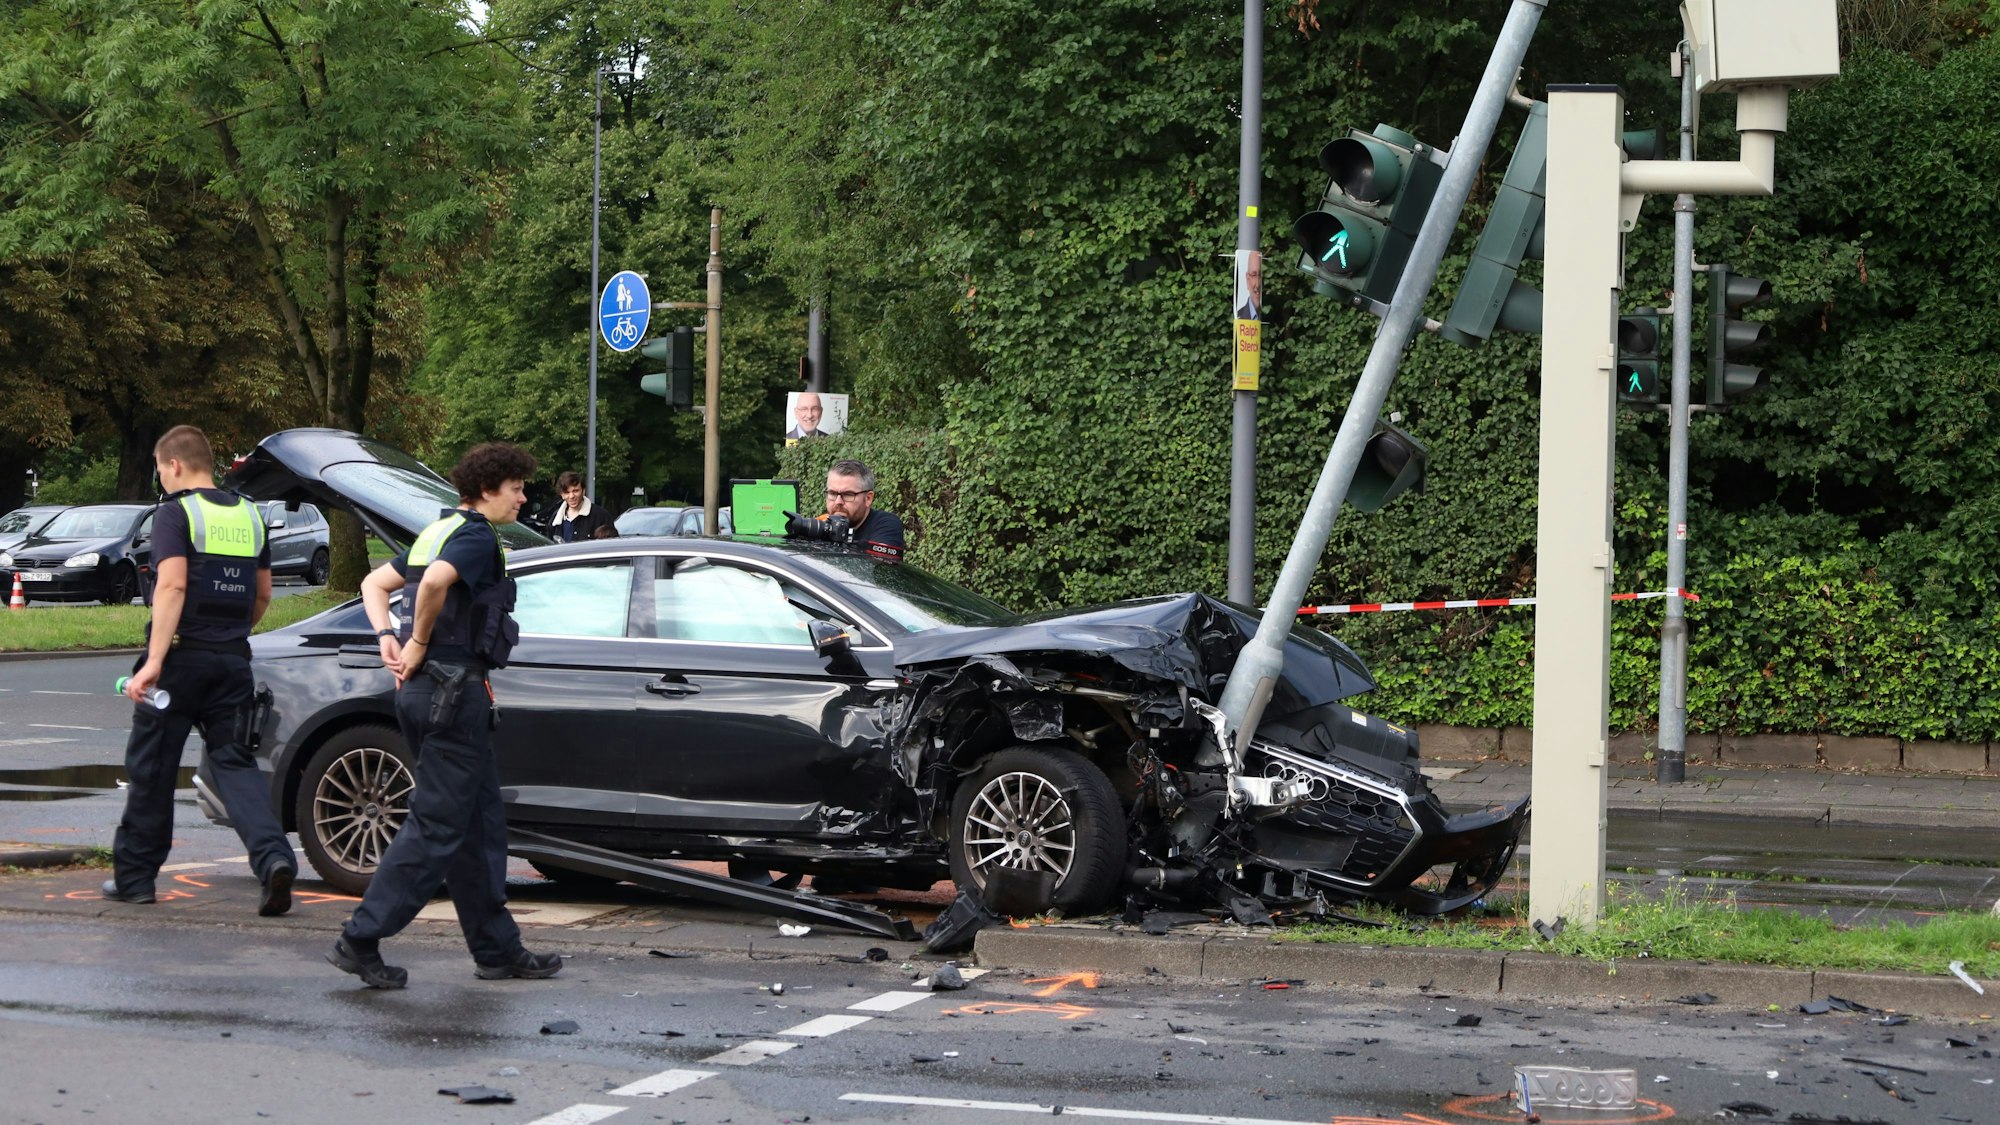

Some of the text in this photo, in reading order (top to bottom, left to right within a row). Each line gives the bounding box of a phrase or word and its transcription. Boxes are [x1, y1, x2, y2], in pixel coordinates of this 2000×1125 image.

[1240, 324, 1258, 339] Ralph
[210, 525, 251, 544] POLIZEI
[872, 545, 887, 553] EOS
[223, 566, 240, 578] VU
[213, 580, 246, 593] Team
